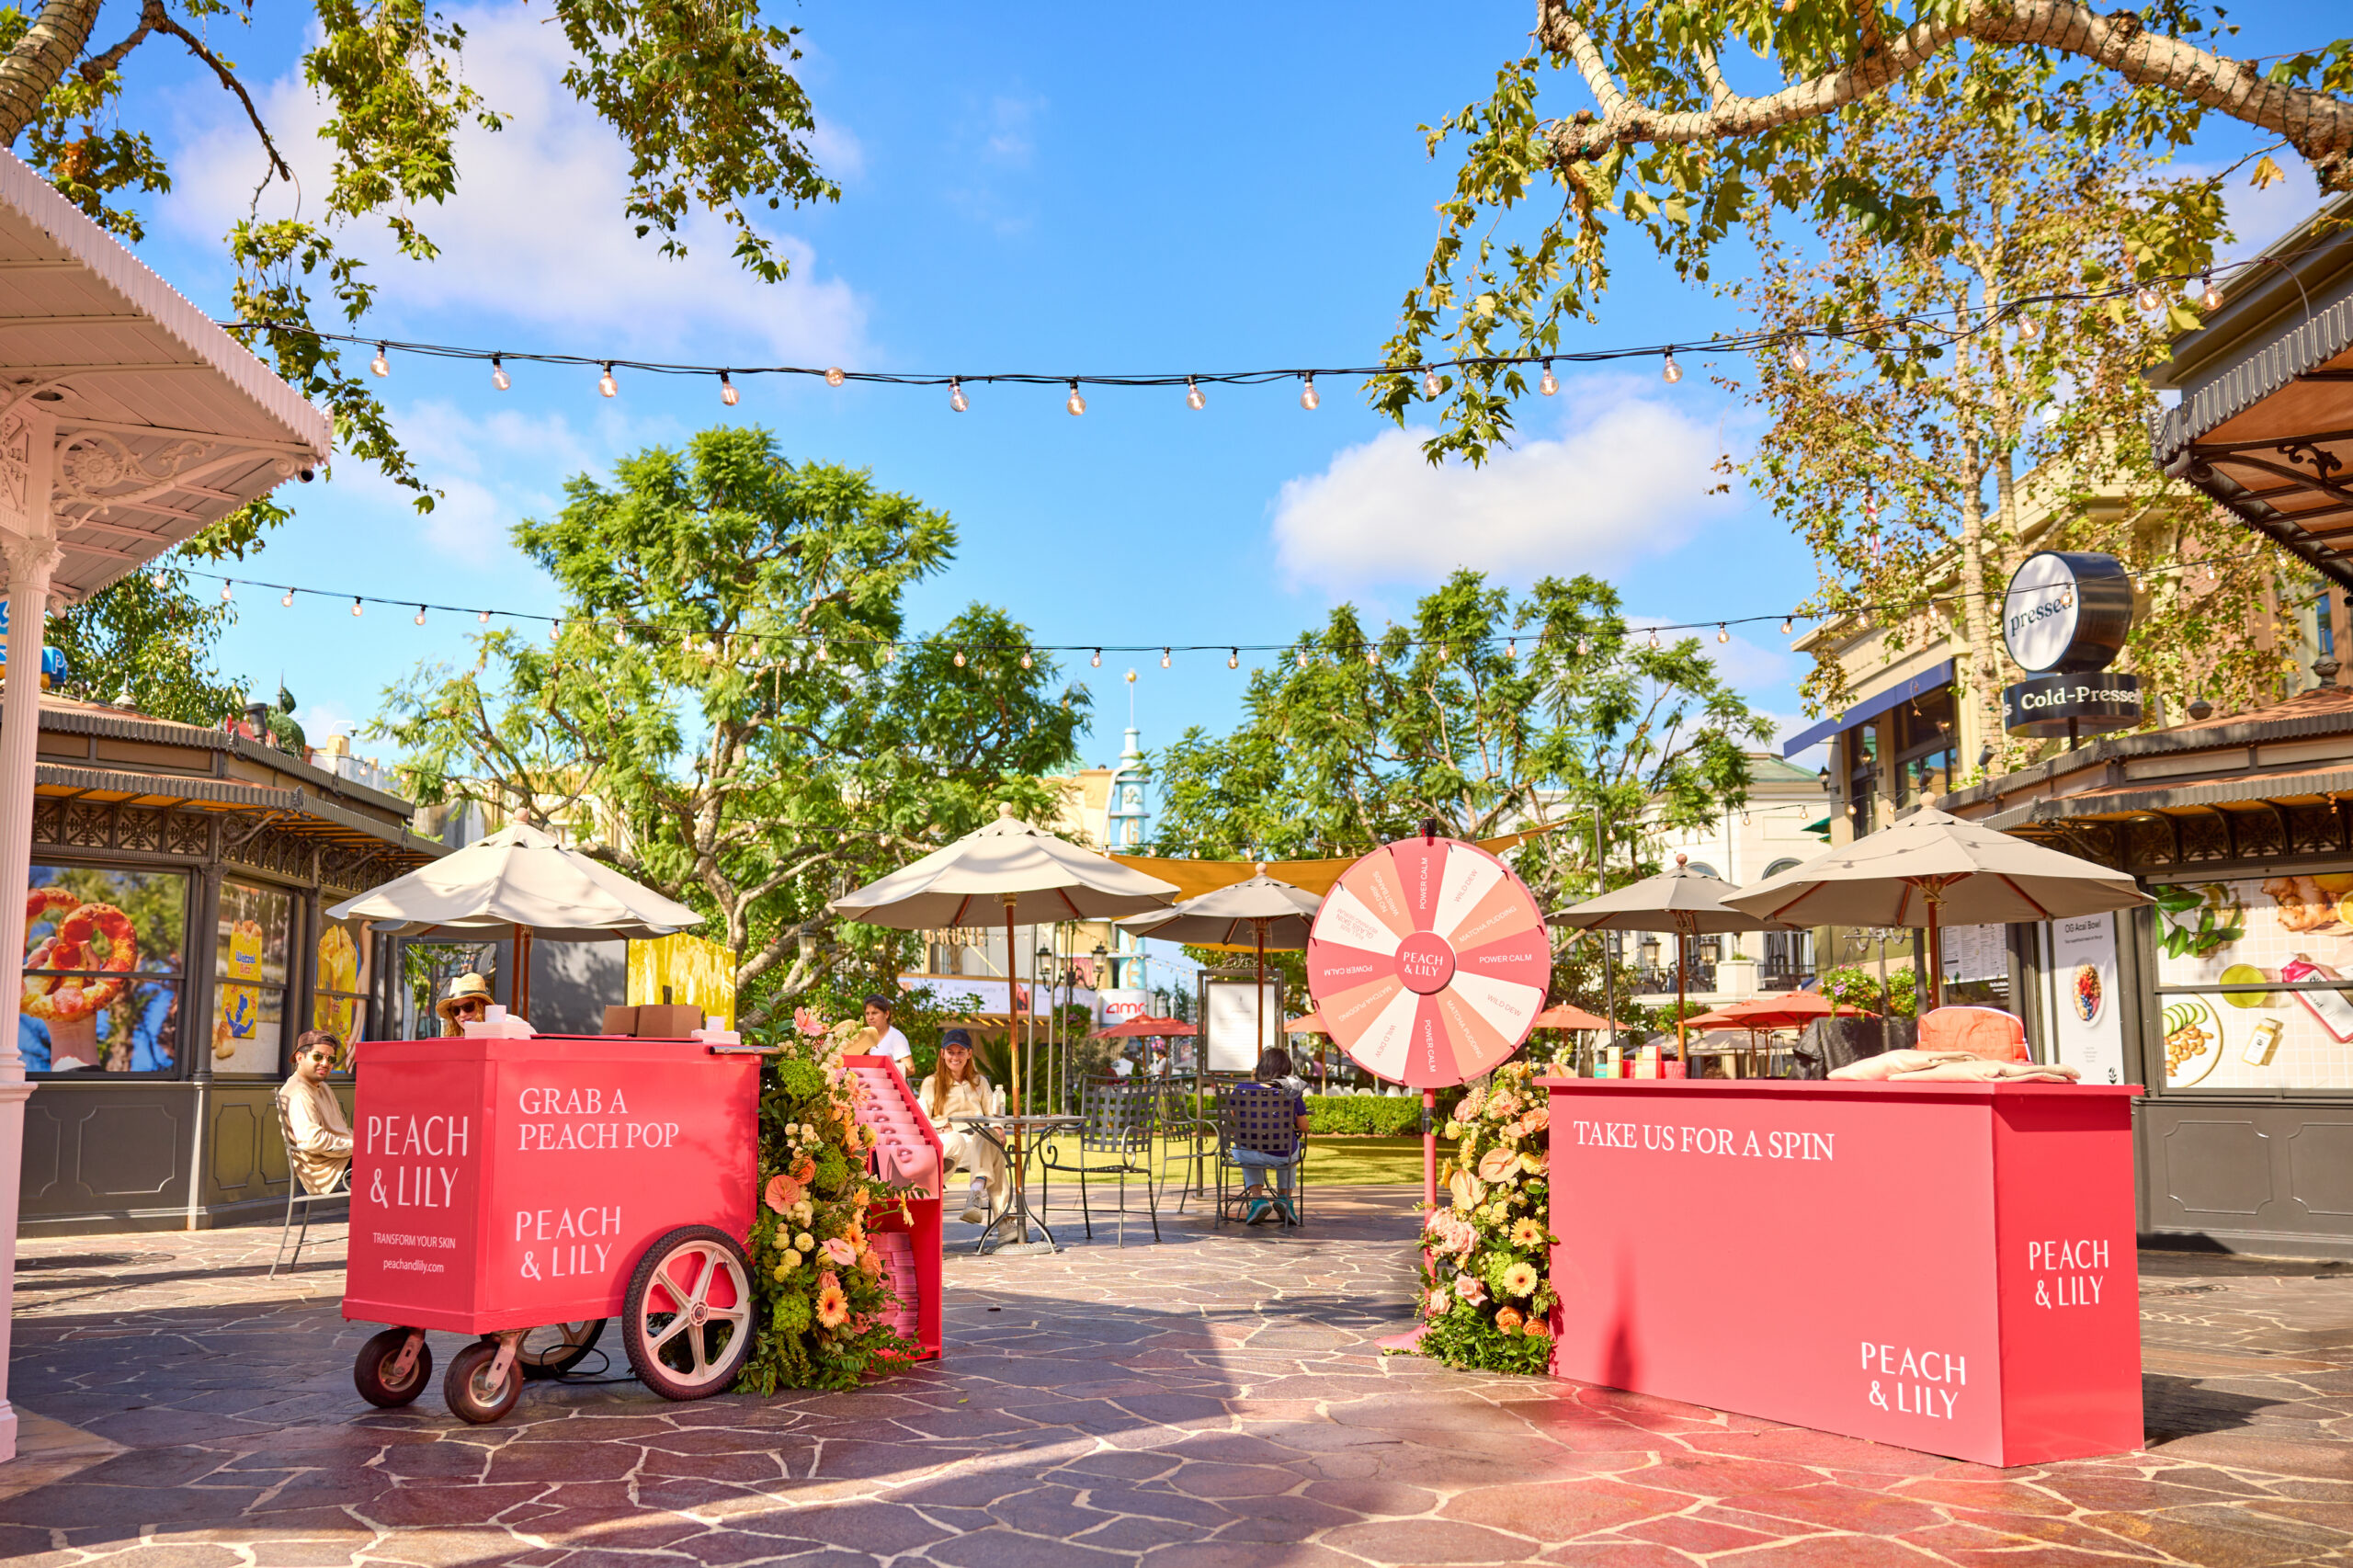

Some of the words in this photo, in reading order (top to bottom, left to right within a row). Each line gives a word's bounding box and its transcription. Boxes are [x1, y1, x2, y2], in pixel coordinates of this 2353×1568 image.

[1372, 870, 1399, 916] WRISTBANDS
[1455, 885, 1468, 903] WILD
[1467, 869, 1478, 886] DEW
[1379, 901, 1388, 913] NO
[1336, 914, 1351, 927] SKIN
[1352, 923, 1374, 939] GLASS
[1459, 923, 1487, 942] MATCHA
[1486, 905, 1518, 926] PUDDING
[1346, 964, 1372, 974] POWER
[1403, 951, 1443, 966] PEACH
[1404, 964, 1412, 974] &
[1415, 964, 1438, 976] LILY
[1479, 955, 1508, 963] POWER
[1509, 953, 1532, 962] CALM
[1324, 967, 1345, 976] CALM
[1366, 985, 1392, 1005] MATCHA
[1487, 994, 1506, 1008] WILD
[1504, 1004, 1522, 1017] DEW
[1338, 1002, 1367, 1022] PUDDING
[1383, 1024, 1397, 1043] WILD
[1425, 1019, 1434, 1048] POWER
[1447, 999, 1466, 1028] MATCHA
[1463, 1028, 1483, 1059] PUDDING
[1375, 1041, 1387, 1058] DEW
[1427, 1050, 1437, 1073] CALM
[519, 1087, 602, 1114] GRAB
[608, 1088, 629, 1113] A
[368, 1114, 469, 1156] PEACH
[518, 1123, 620, 1151] PEACH
[626, 1122, 679, 1148] POP
[1574, 1120, 1637, 1148] TAKE
[1643, 1125, 1675, 1151] US
[1680, 1127, 1736, 1155] FOR
[1742, 1131, 1763, 1157] A
[1768, 1131, 1835, 1161] SPIN
[369, 1168, 389, 1209] &
[398, 1165, 459, 1209] LILY
[516, 1206, 621, 1242] PEACH
[372, 1233, 415, 1248] TRANSFORM
[416, 1235, 437, 1249] YOUR
[437, 1236, 456, 1249] SKIN
[382, 1257, 445, 1274] peachandlily.com
[520, 1252, 541, 1281] &
[551, 1243, 612, 1278] LILY
[2029, 1239, 2109, 1271] PEACH
[2035, 1279, 2052, 1310] &
[2058, 1275, 2103, 1306] LILY
[1861, 1342, 1966, 1385] PEACH
[1869, 1381, 1890, 1412] &
[1897, 1382, 1959, 1420] LILY
